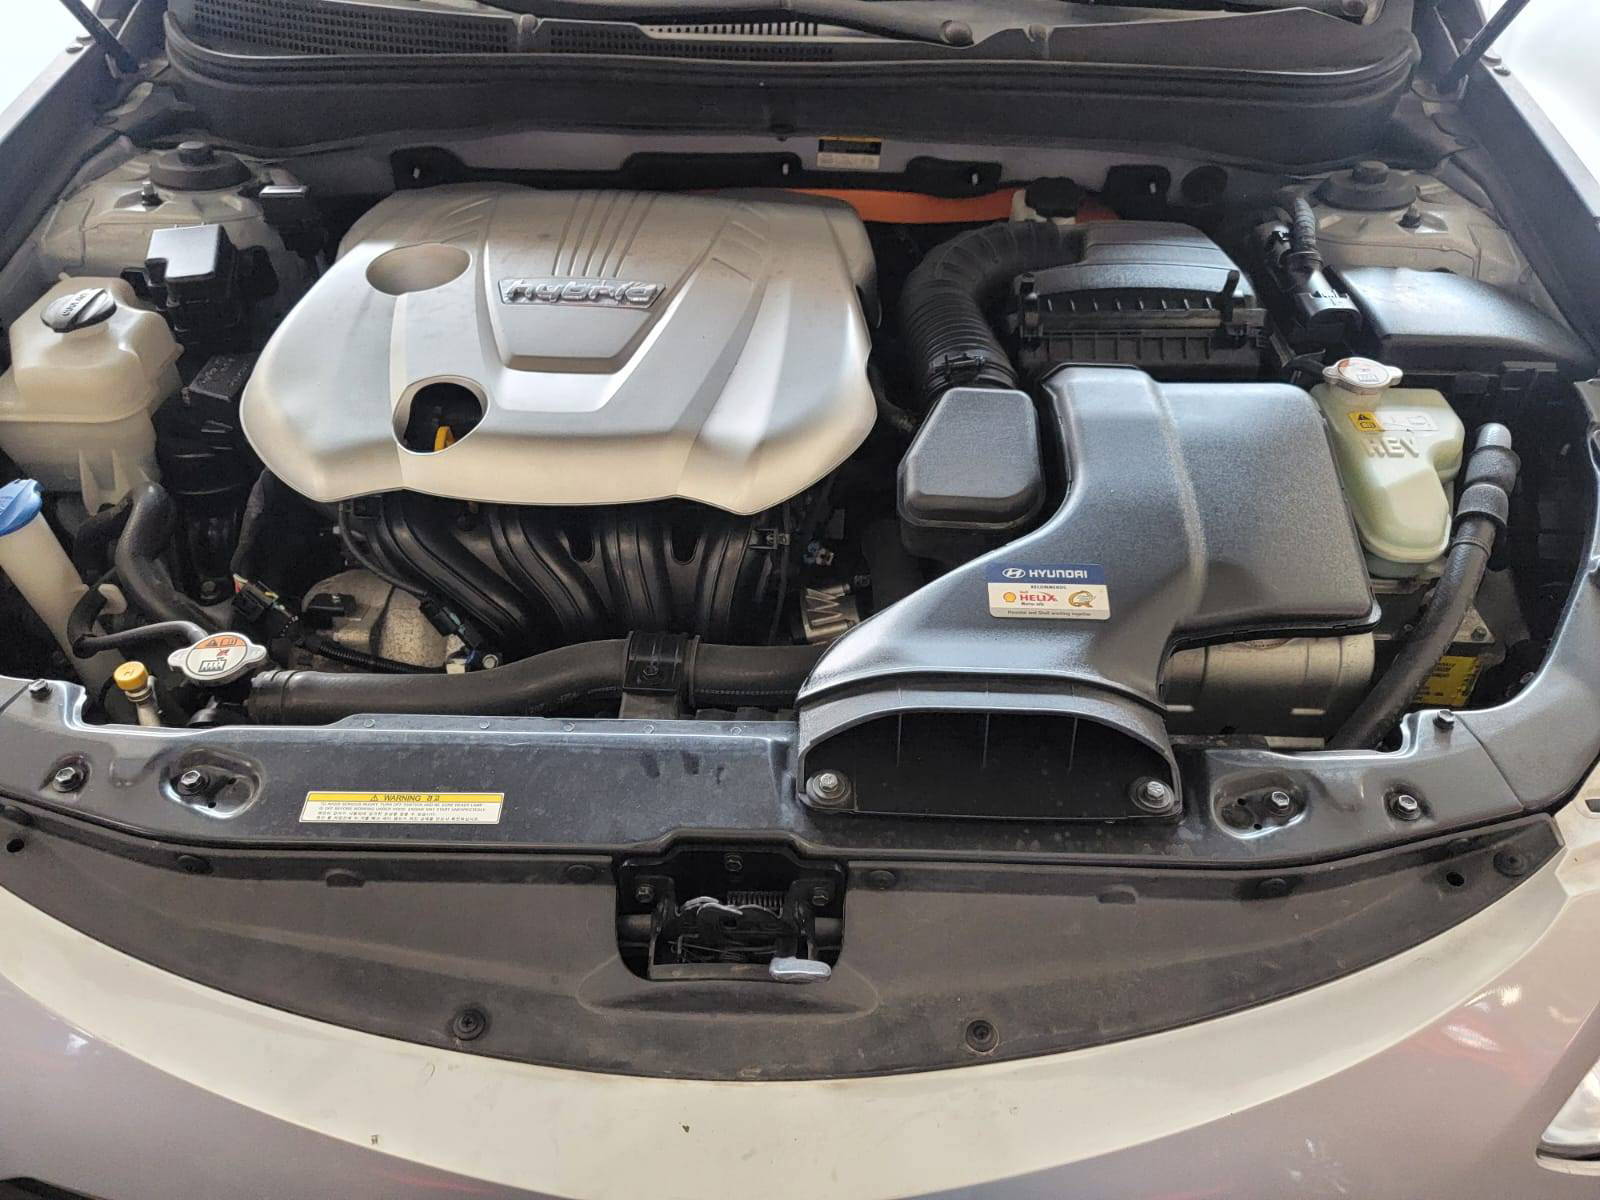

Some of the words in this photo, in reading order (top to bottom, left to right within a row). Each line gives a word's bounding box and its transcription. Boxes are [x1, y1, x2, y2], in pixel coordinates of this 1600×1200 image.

[1029, 569, 1088, 579] HYUNDAI
[1020, 593, 1057, 602] HELIX
[384, 794, 421, 802] WARNING
